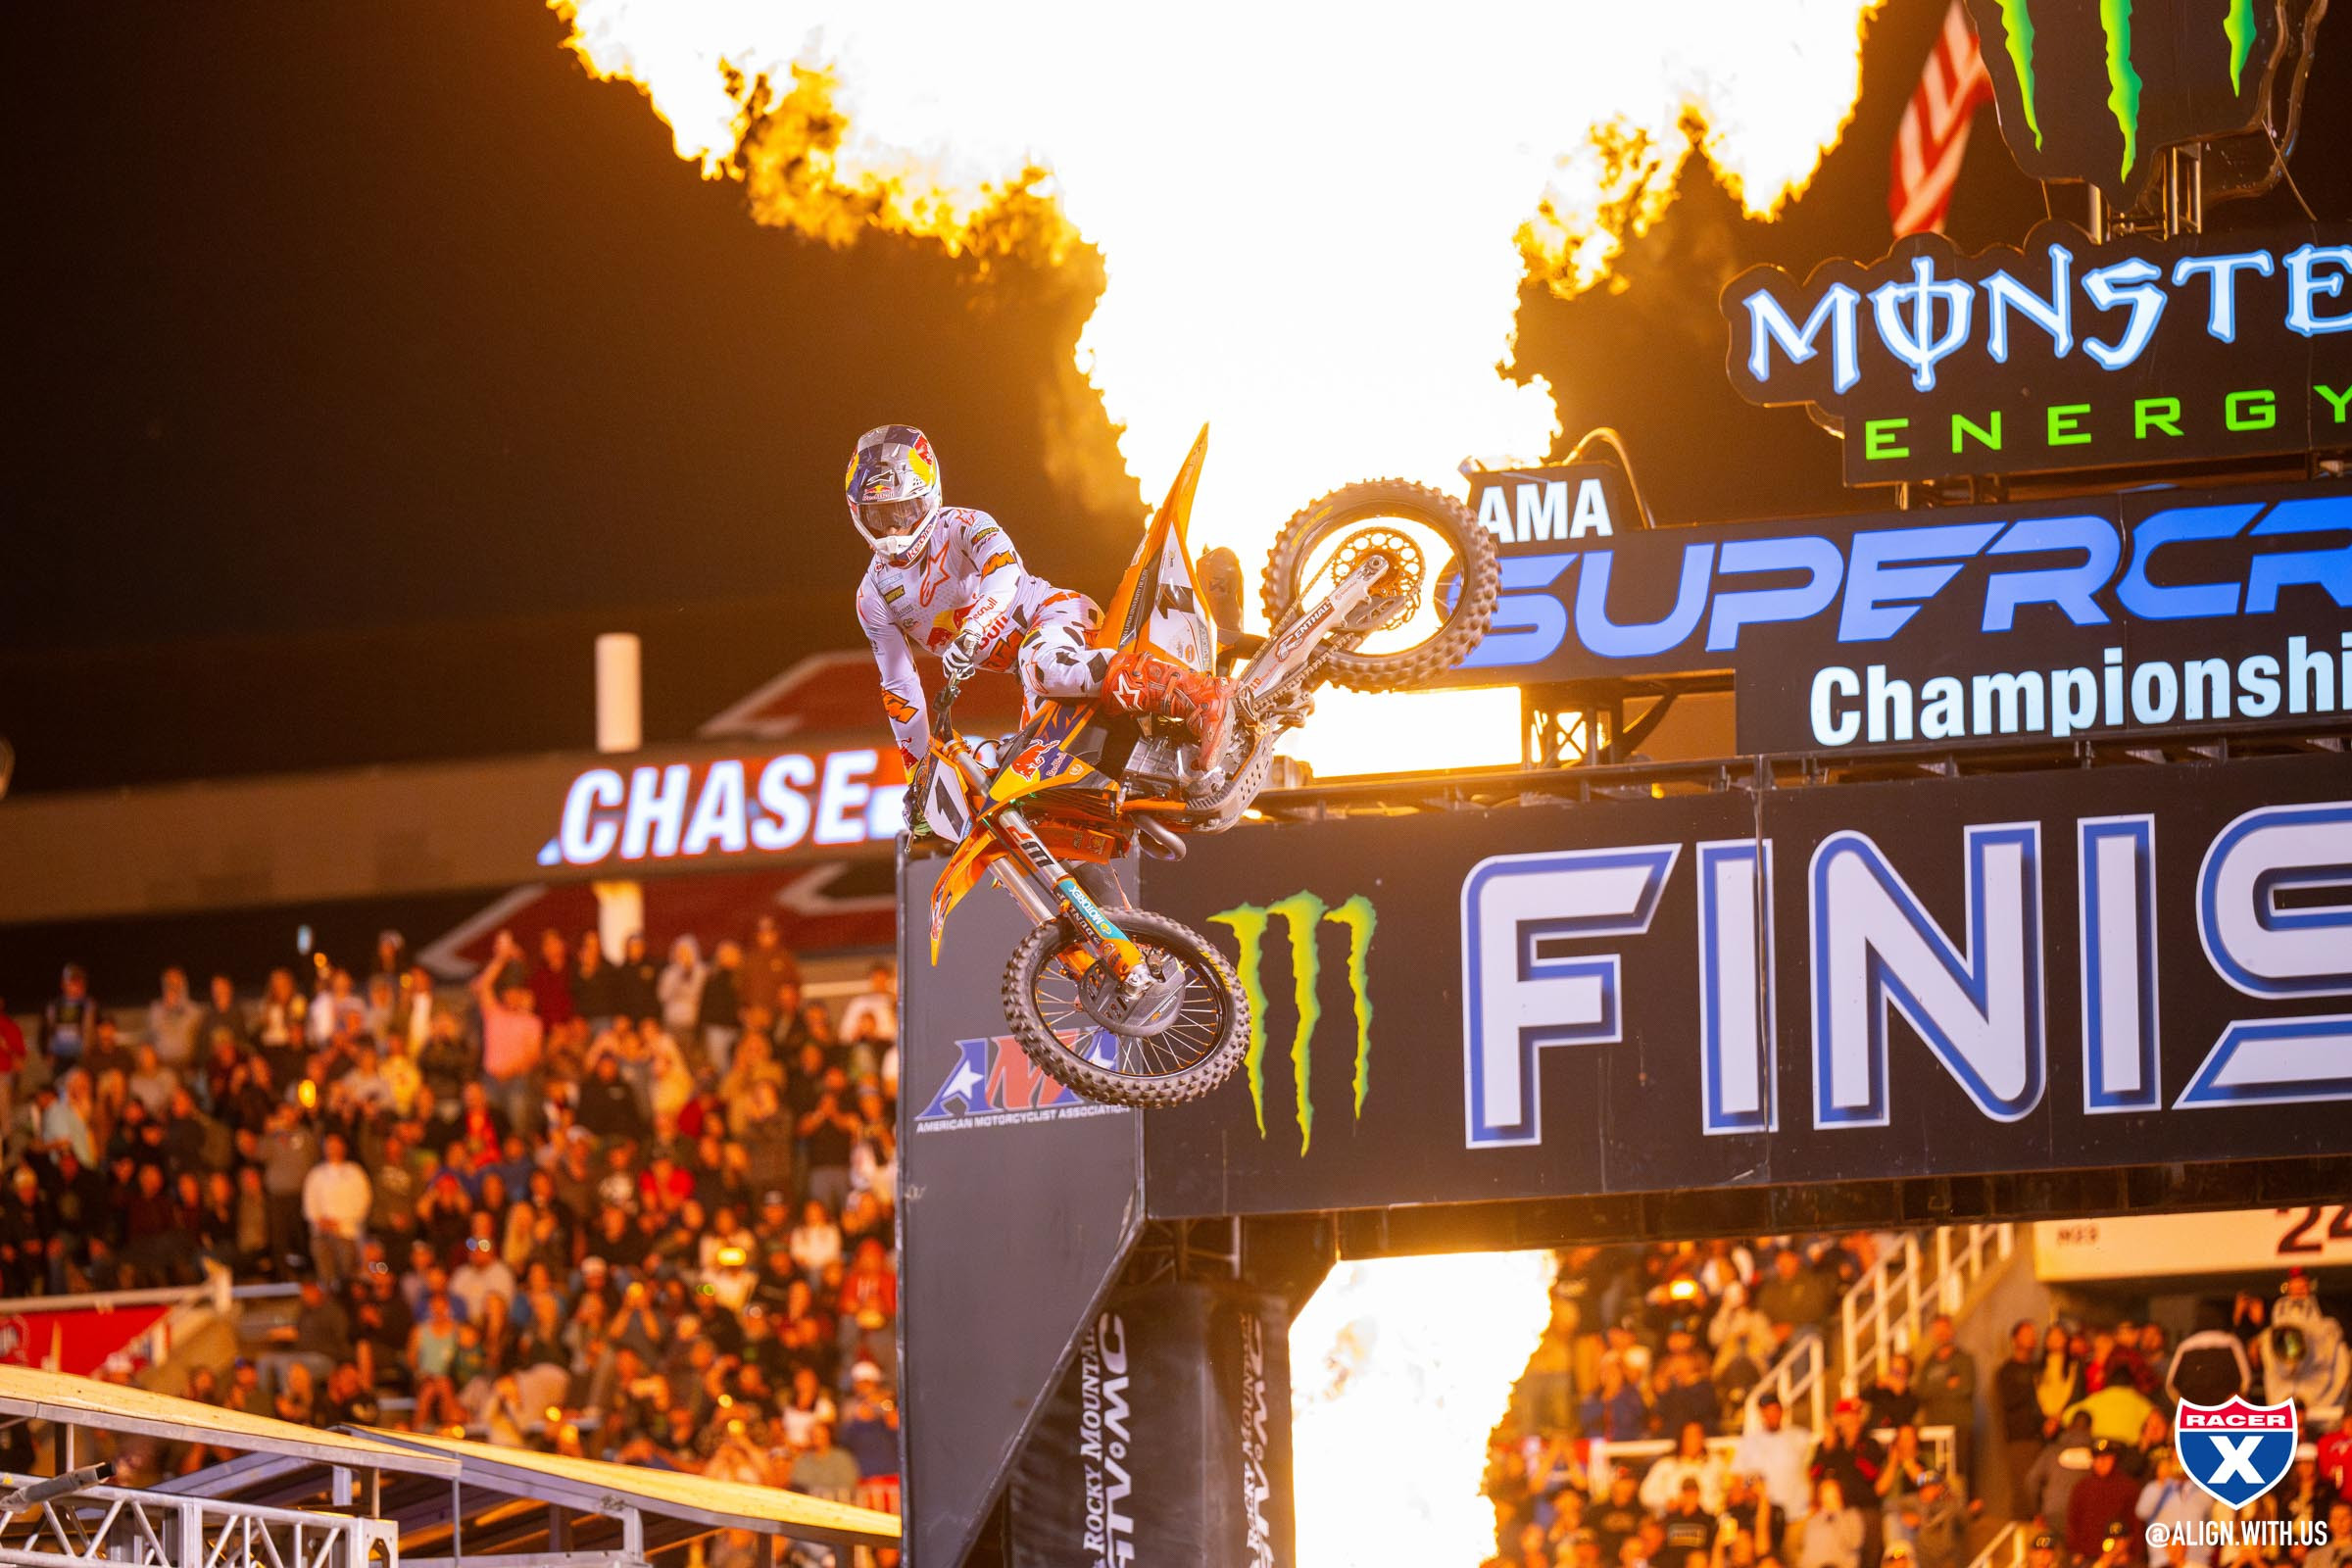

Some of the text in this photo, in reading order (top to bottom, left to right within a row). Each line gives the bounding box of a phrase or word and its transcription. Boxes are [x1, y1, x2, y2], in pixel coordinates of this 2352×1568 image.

[1865, 382, 2352, 460] ENERGY
[1478, 478, 1613, 544] AMA
[1810, 631, 2352, 746] Championshi
[559, 749, 879, 865] CHASE
[934, 775, 965, 839] 1
[1056, 893, 1095, 937] DUNLP
[1069, 885, 1105, 925] MOTOREX
[1460, 802, 2352, 1151] FINIS
[916, 1115, 973, 1133] AMERICAN
[974, 1108, 1056, 1127] MOTORCYCLIST
[1083, 1465, 1105, 1554] ROCKY
